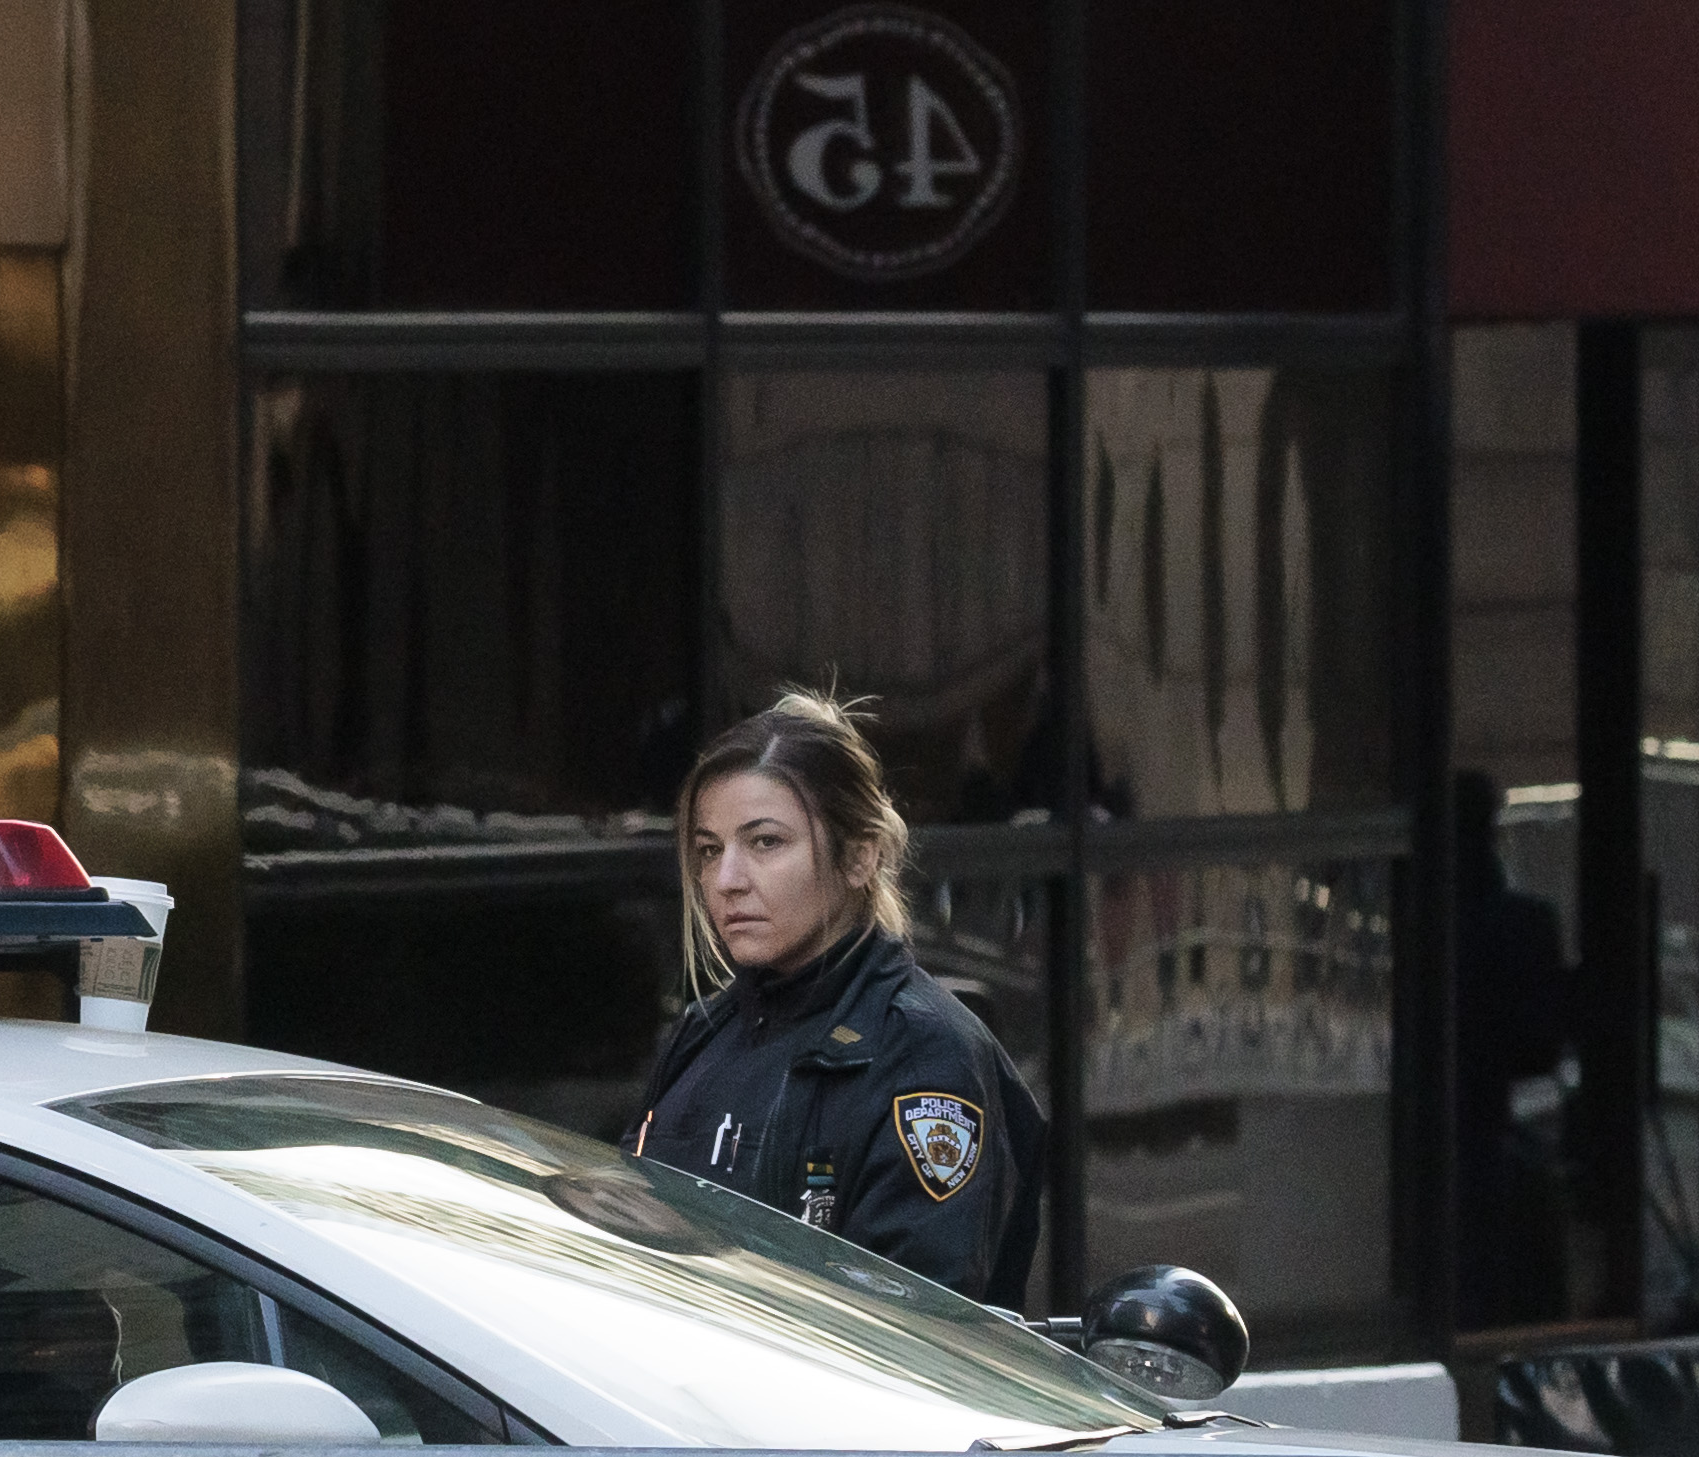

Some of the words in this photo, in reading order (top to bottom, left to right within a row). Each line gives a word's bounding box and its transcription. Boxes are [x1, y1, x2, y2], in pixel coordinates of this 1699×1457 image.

[905, 1107, 977, 1132] DEPARTMENT
[920, 1097, 962, 1115] POLICE
[906, 1133, 925, 1159] CITY
[921, 1162, 935, 1179] OF
[946, 1169, 966, 1189] NEW
[963, 1141, 978, 1168] YORK
